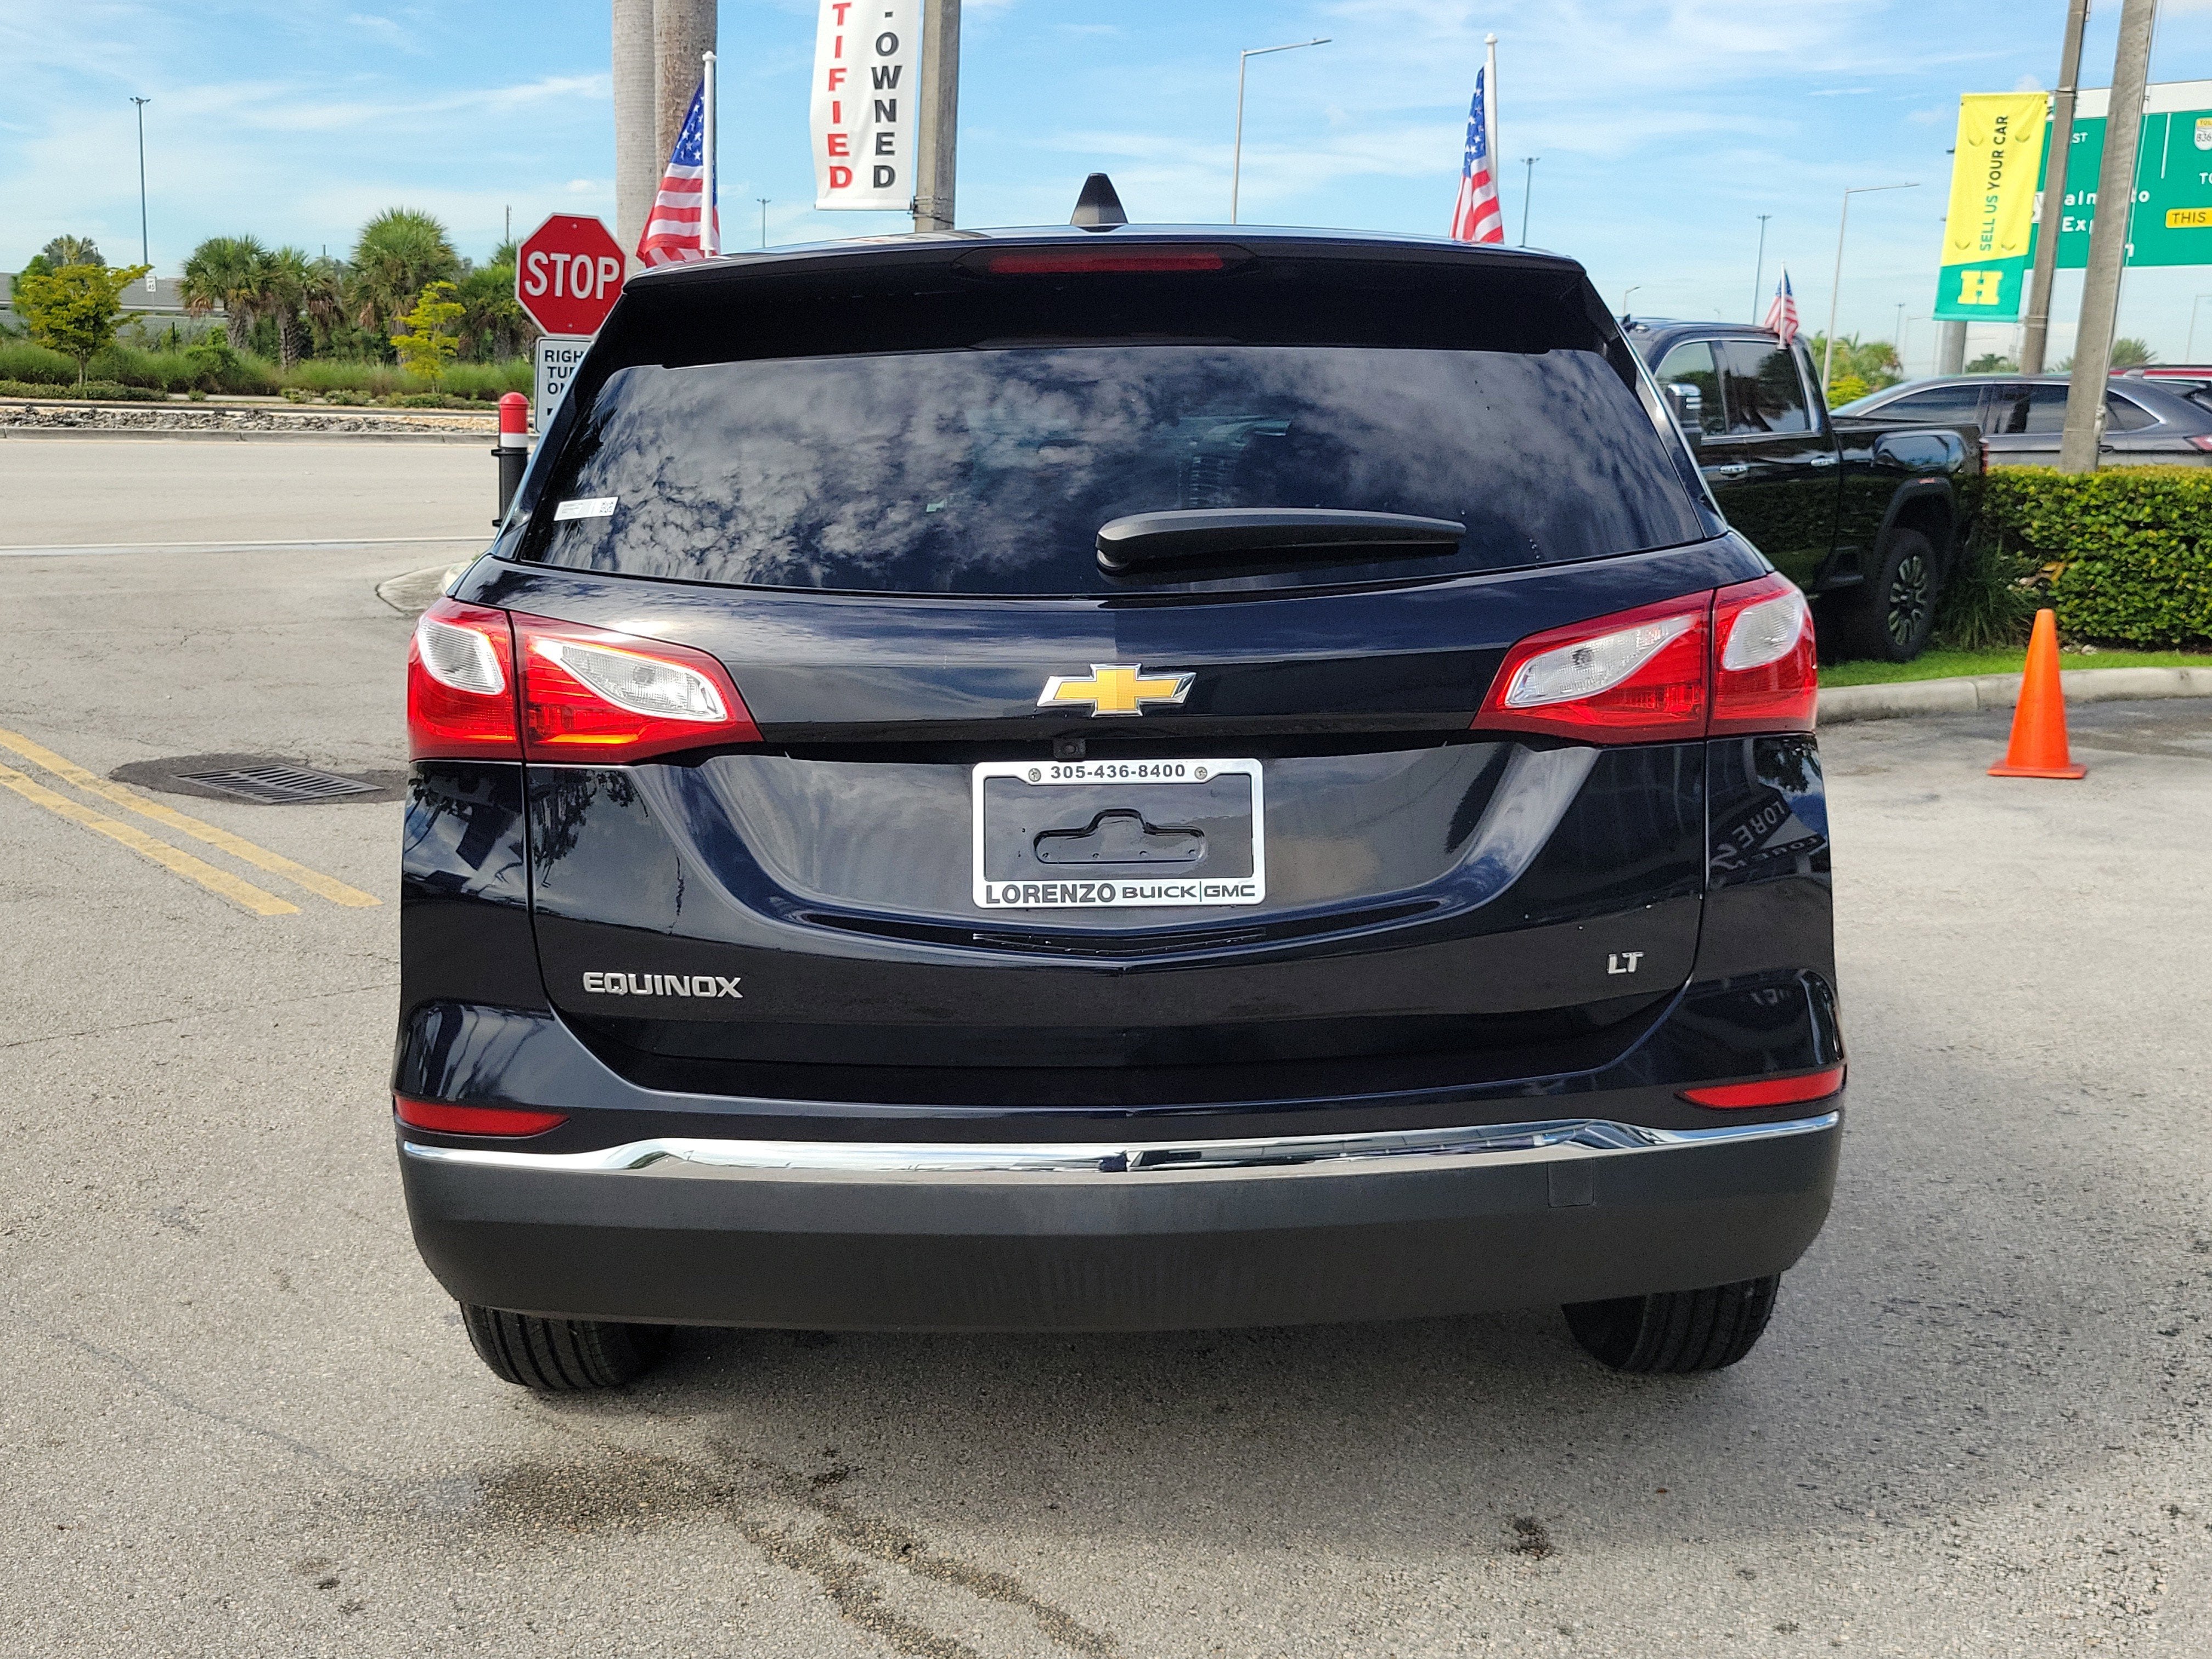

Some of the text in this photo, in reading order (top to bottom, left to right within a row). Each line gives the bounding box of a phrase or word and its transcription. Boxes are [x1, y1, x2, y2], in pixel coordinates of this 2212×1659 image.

[1979, 116, 2008, 251] SELL US YOUR CAR
[2172, 212, 2207, 224] THIS
[524, 250, 620, 300] STOP
[1957, 269, 2004, 305] H
[545, 350, 585, 363] RIGH
[1051, 764, 1186, 779] 305-436-8400
[986, 883, 1256, 905] LORENZO BUICK GMC
[1607, 951, 1644, 974] LT
[583, 972, 743, 998] EQUINOX
